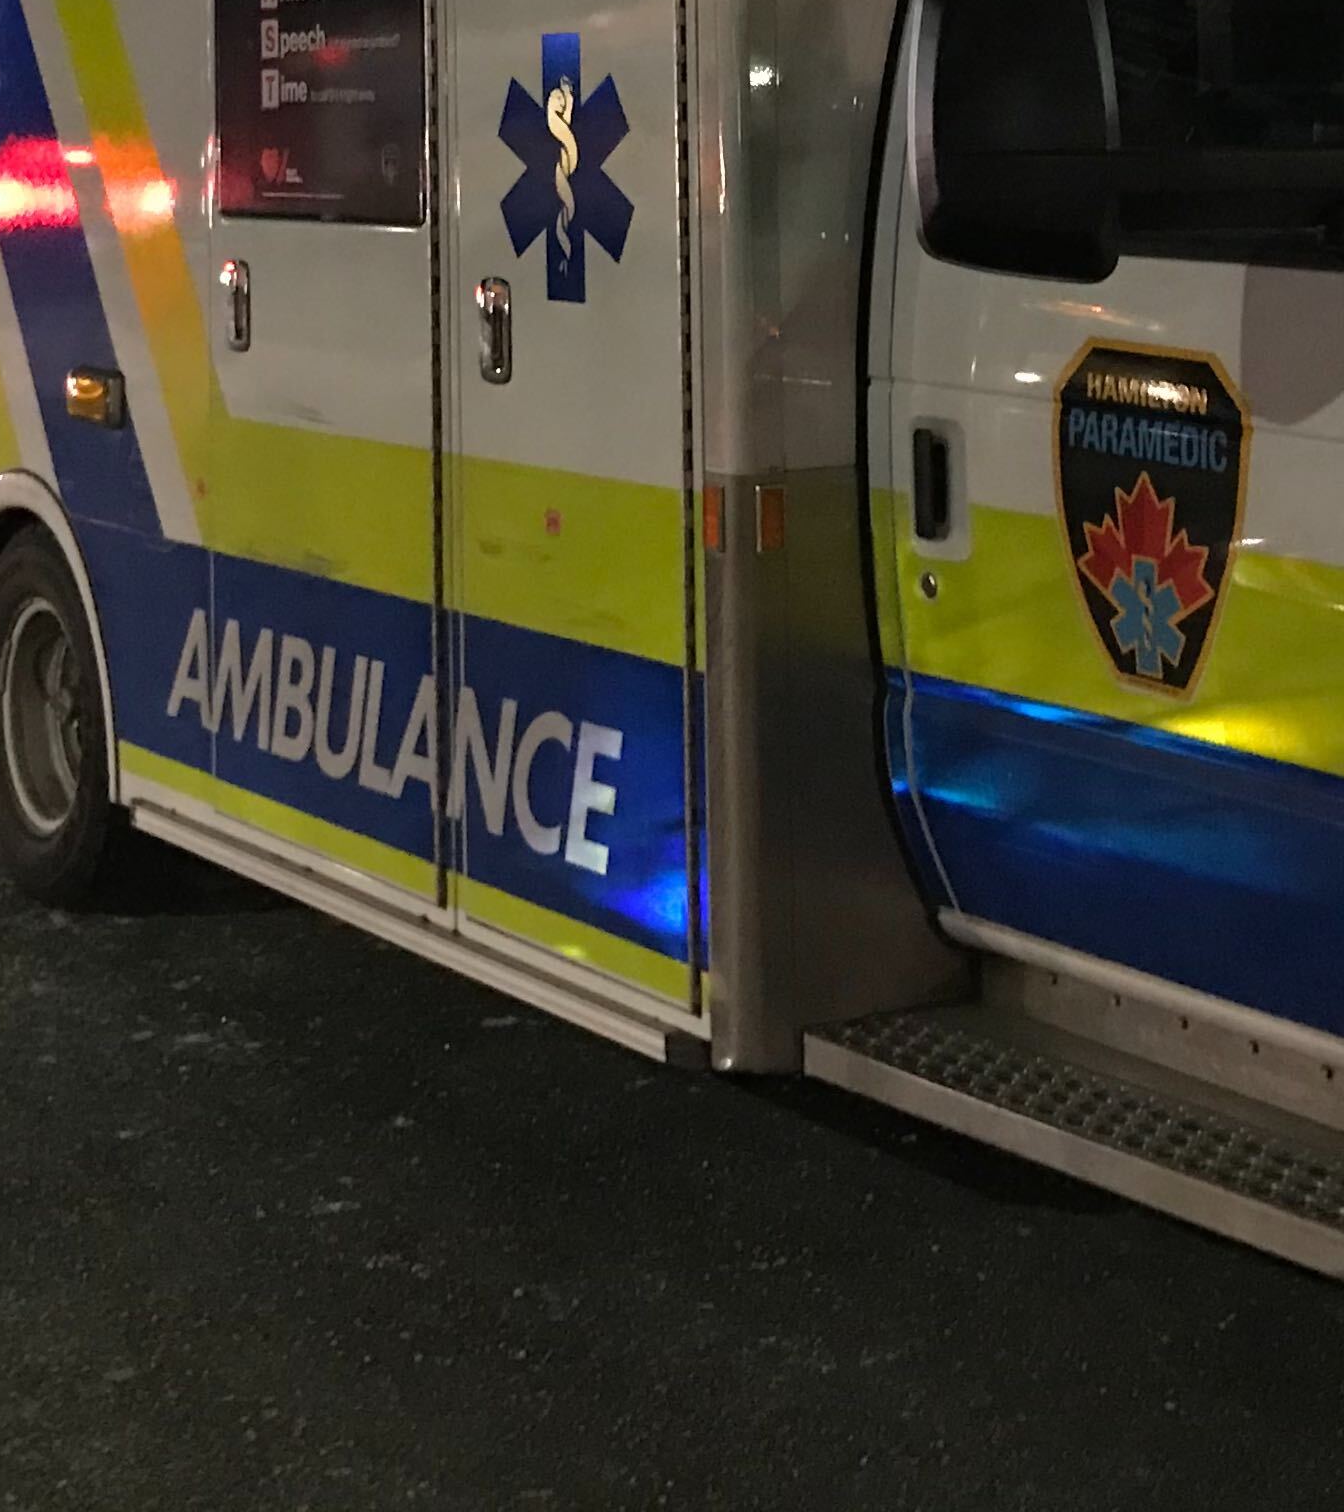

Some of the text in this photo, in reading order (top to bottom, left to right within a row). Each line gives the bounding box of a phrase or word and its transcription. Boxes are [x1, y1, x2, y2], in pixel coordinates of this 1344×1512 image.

[263, 22, 326, 58] Speech
[264, 73, 308, 105] Time
[1086, 371, 1209, 416] HAMILTON
[1067, 407, 1229, 473] PARAMEDIC
[166, 607, 624, 876] AMBULANCE
